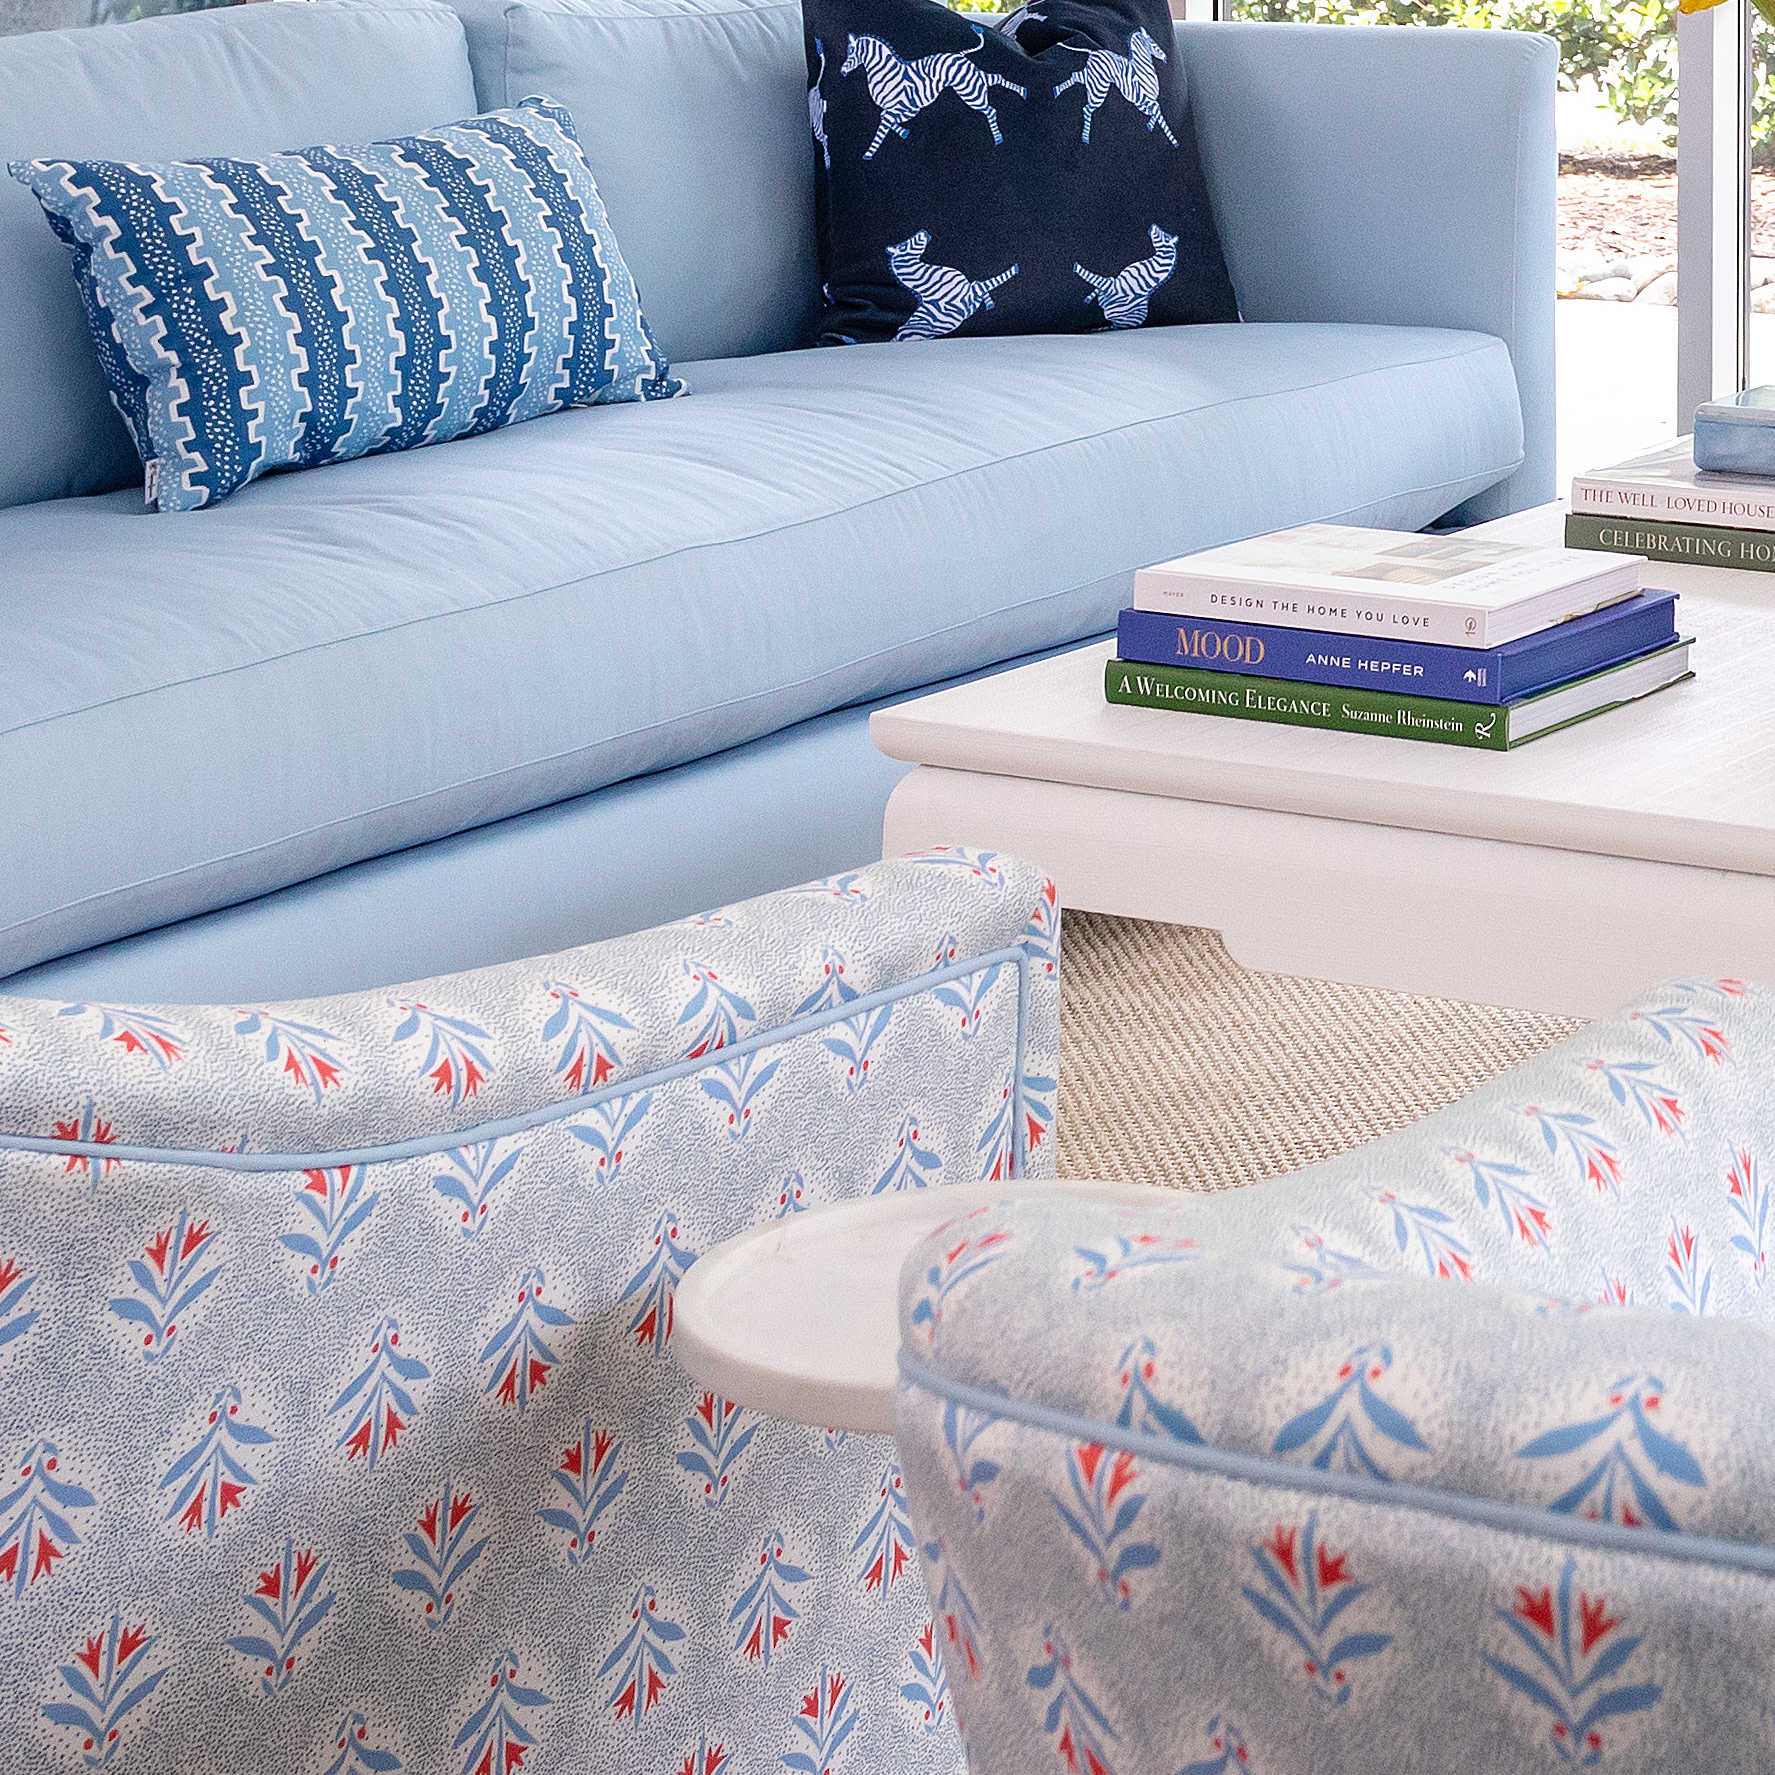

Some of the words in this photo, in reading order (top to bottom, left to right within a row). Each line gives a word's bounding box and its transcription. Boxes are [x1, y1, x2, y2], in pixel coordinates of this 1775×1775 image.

[1581, 487, 1613, 503] THE
[1666, 495, 1718, 513] LOVED
[1722, 501, 1775, 519] HOUSE
[1599, 527, 1731, 558] CELEBRATING
[1211, 593, 1263, 608] DESIGN
[1273, 600, 1298, 612] THE
[1307, 605, 1347, 618] HOME
[1356, 610, 1384, 622] YOU
[1393, 615, 1430, 627] LOVE
[1176, 627, 1265, 664] MOOD
[1306, 653, 1352, 668] ANNE
[1358, 659, 1424, 677] HEPFER
[1118, 675, 1133, 694] A
[1136, 675, 1239, 706] WELCOMING
[1245, 689, 1331, 717] ELEGANCE
[1342, 703, 1393, 724] Suzanne
[1397, 710, 1463, 732] Rheinstein
